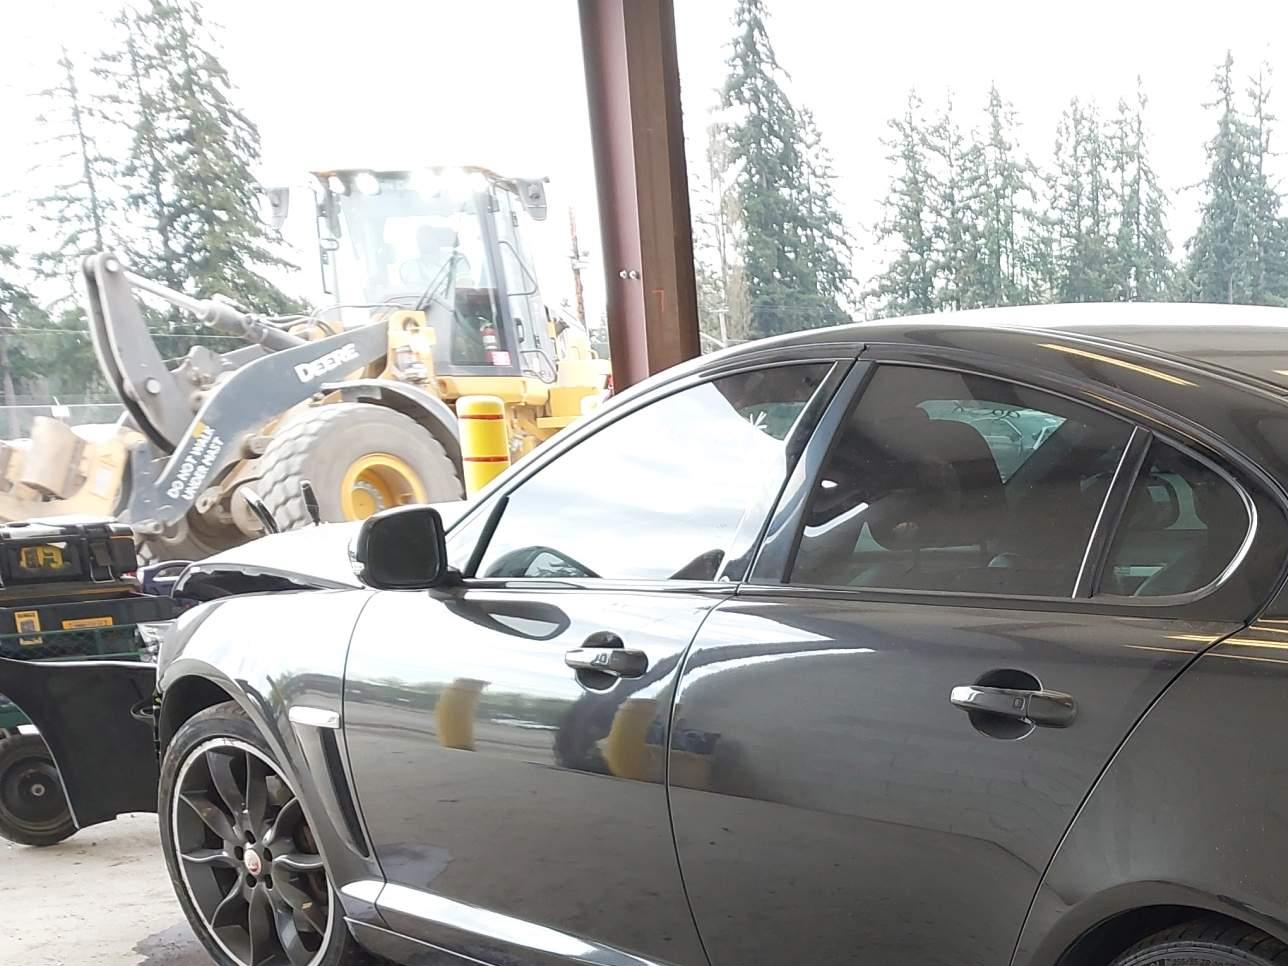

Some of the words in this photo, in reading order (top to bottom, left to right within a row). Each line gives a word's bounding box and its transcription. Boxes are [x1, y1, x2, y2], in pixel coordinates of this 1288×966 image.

[294, 343, 360, 383] DEERE
[166, 480, 185, 499] DO
[176, 455, 198, 481] NOT
[189, 425, 216, 456] WALK
[181, 465, 210, 500] UNDER
[201, 436, 224, 466] MAST
